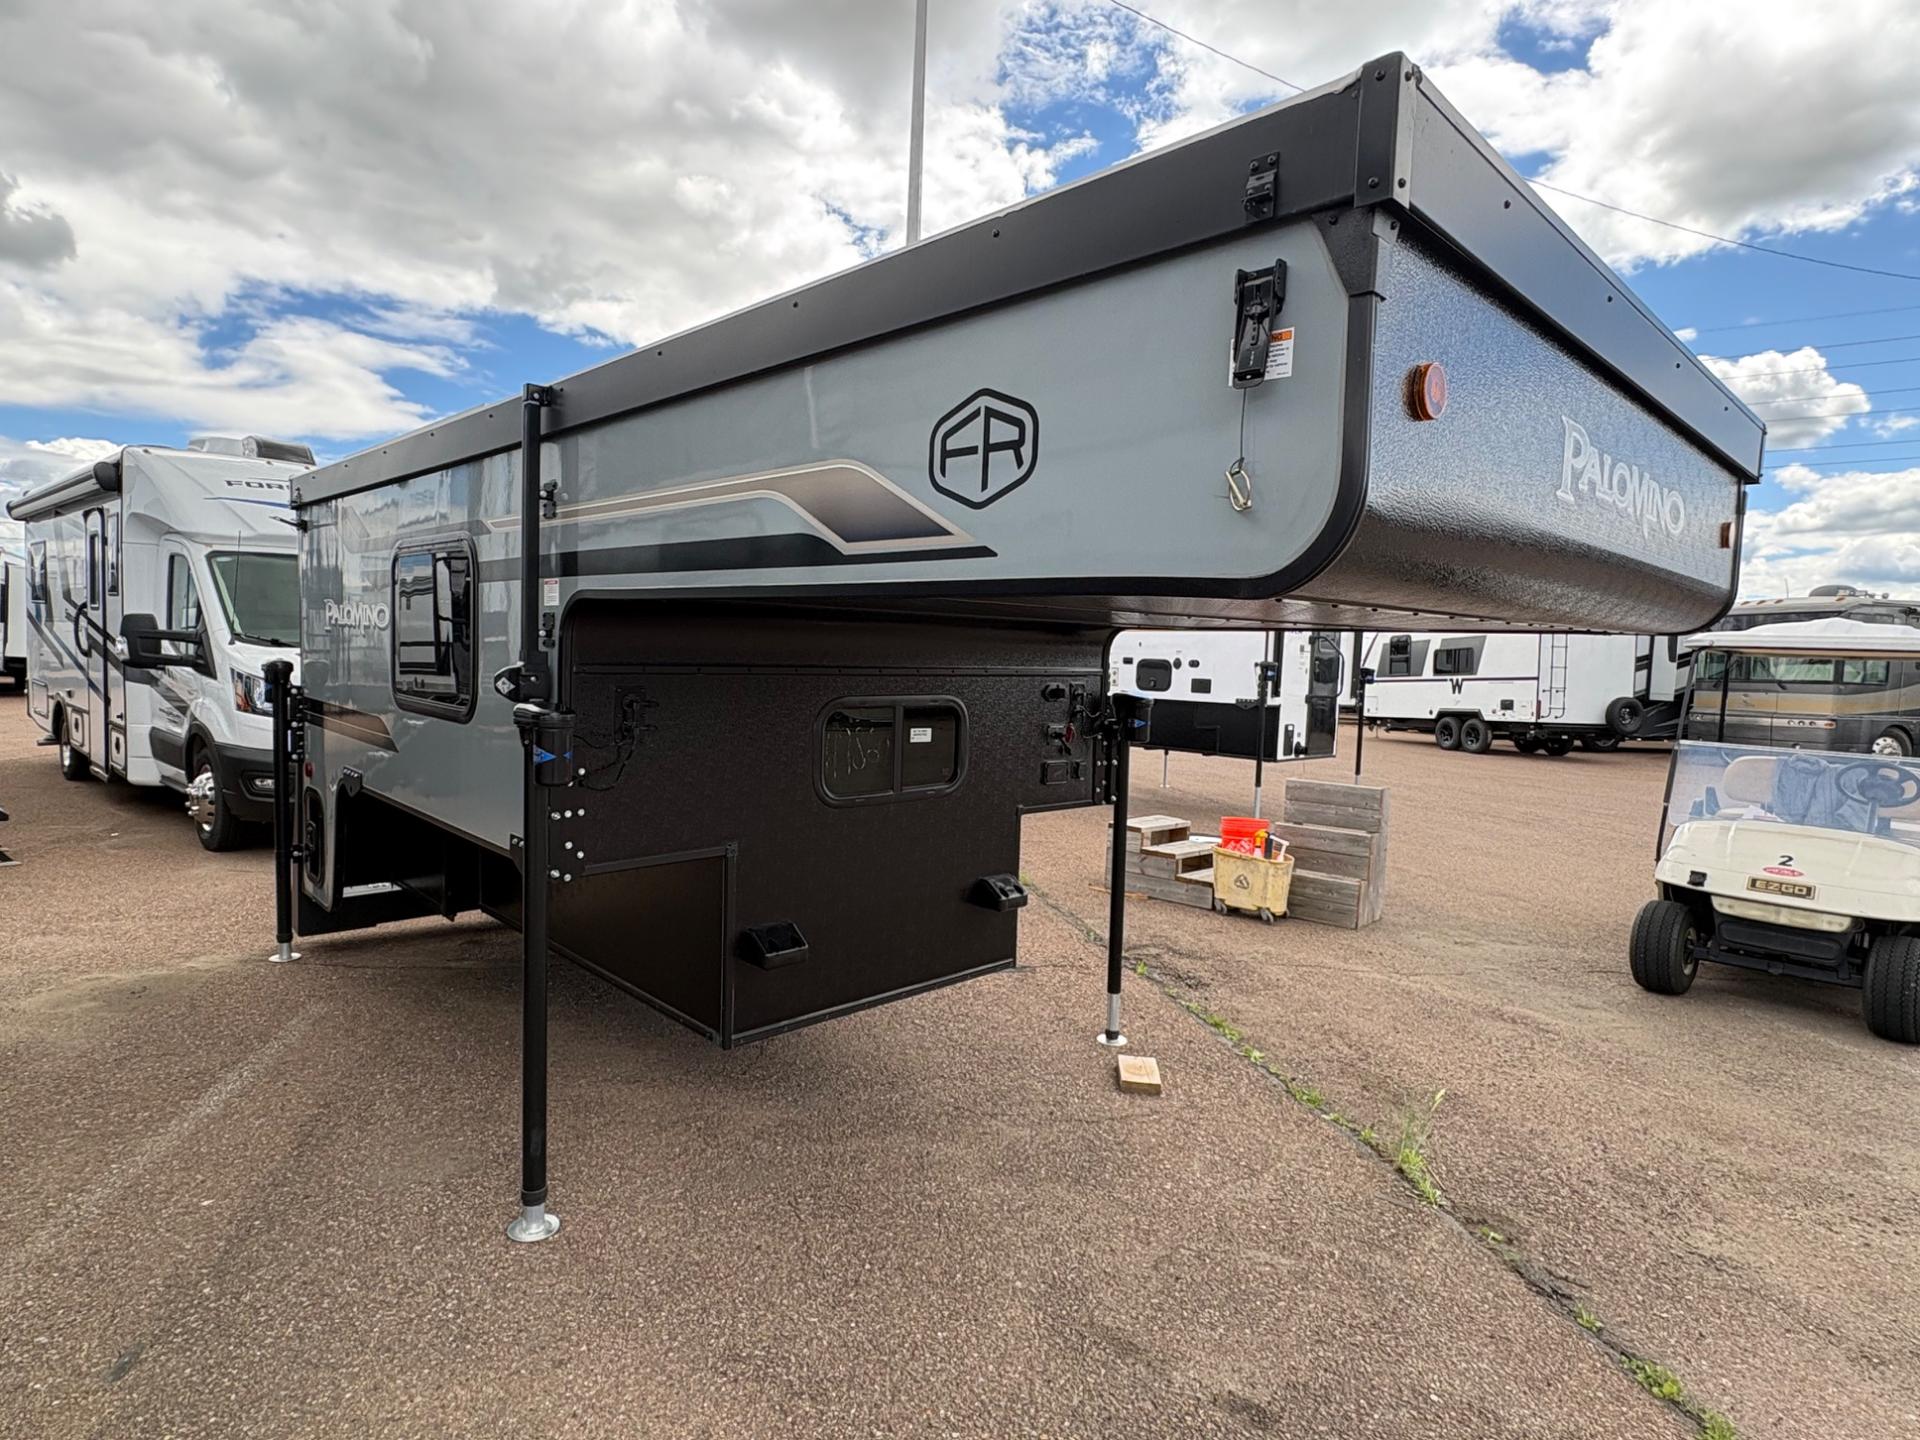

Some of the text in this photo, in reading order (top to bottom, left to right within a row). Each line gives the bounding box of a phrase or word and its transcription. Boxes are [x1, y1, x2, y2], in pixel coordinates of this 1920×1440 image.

[225, 480, 290, 490] FOR
[1556, 415, 1685, 541] PALOMINO
[323, 598, 390, 635] PALOMINO
[1778, 855, 1794, 866] 2
